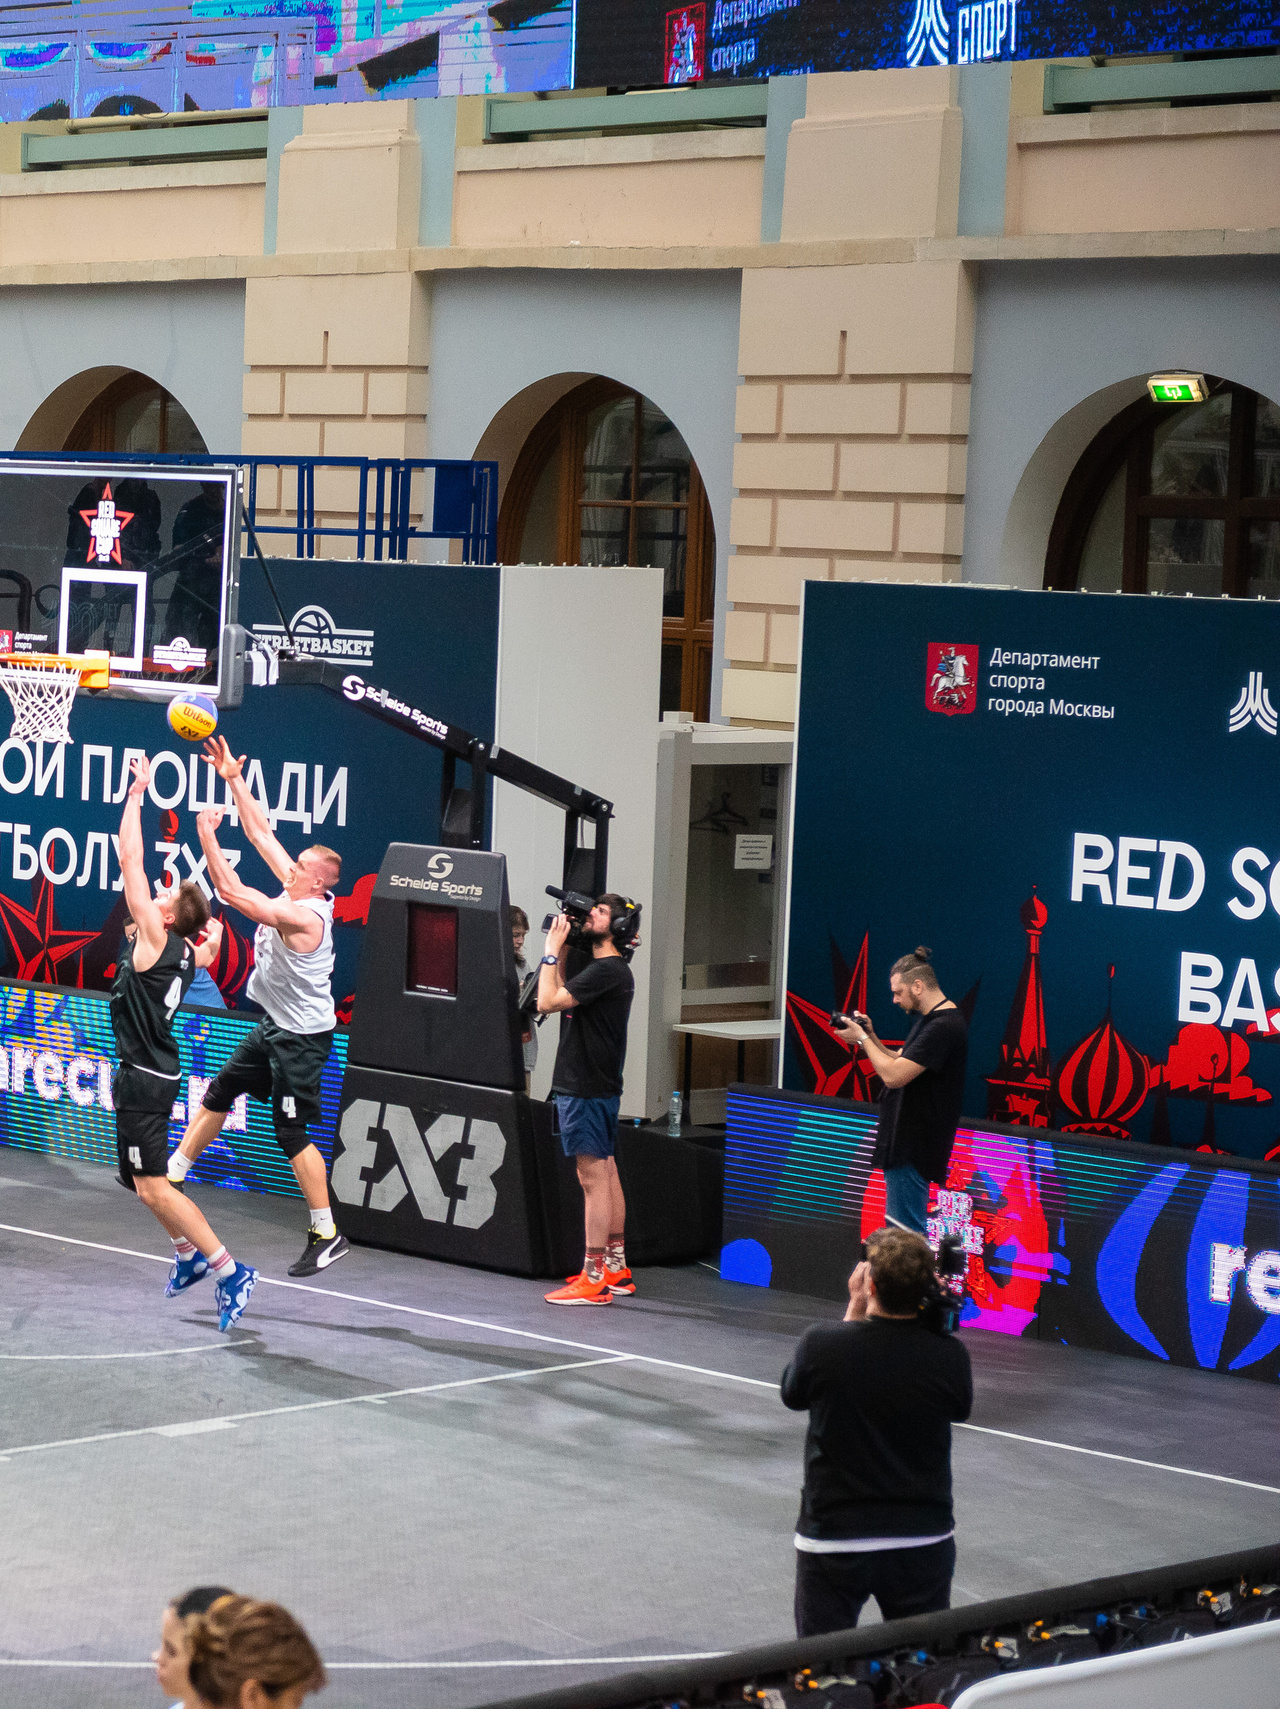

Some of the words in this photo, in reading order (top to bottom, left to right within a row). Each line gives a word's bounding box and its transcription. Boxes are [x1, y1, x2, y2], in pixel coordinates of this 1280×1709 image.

[957, 0, 1020, 65] СПОРТ
[989, 647, 1101, 670] Департамент
[989, 674, 1045, 693] спорта
[183, 705, 212, 728] Wilson
[365, 686, 411, 717] Scelde
[411, 708, 448, 735] Sports
[988, 698, 1045, 717] города
[1049, 698, 1115, 719] Москвы
[81, 743, 349, 835] ПЛОЩАДИ
[1071, 832, 1206, 912] RED
[389, 874, 439, 892] Schelde
[440, 881, 483, 896] Sports
[281, 1096, 297, 1119] 4
[128, 1145, 142, 1170] 4
